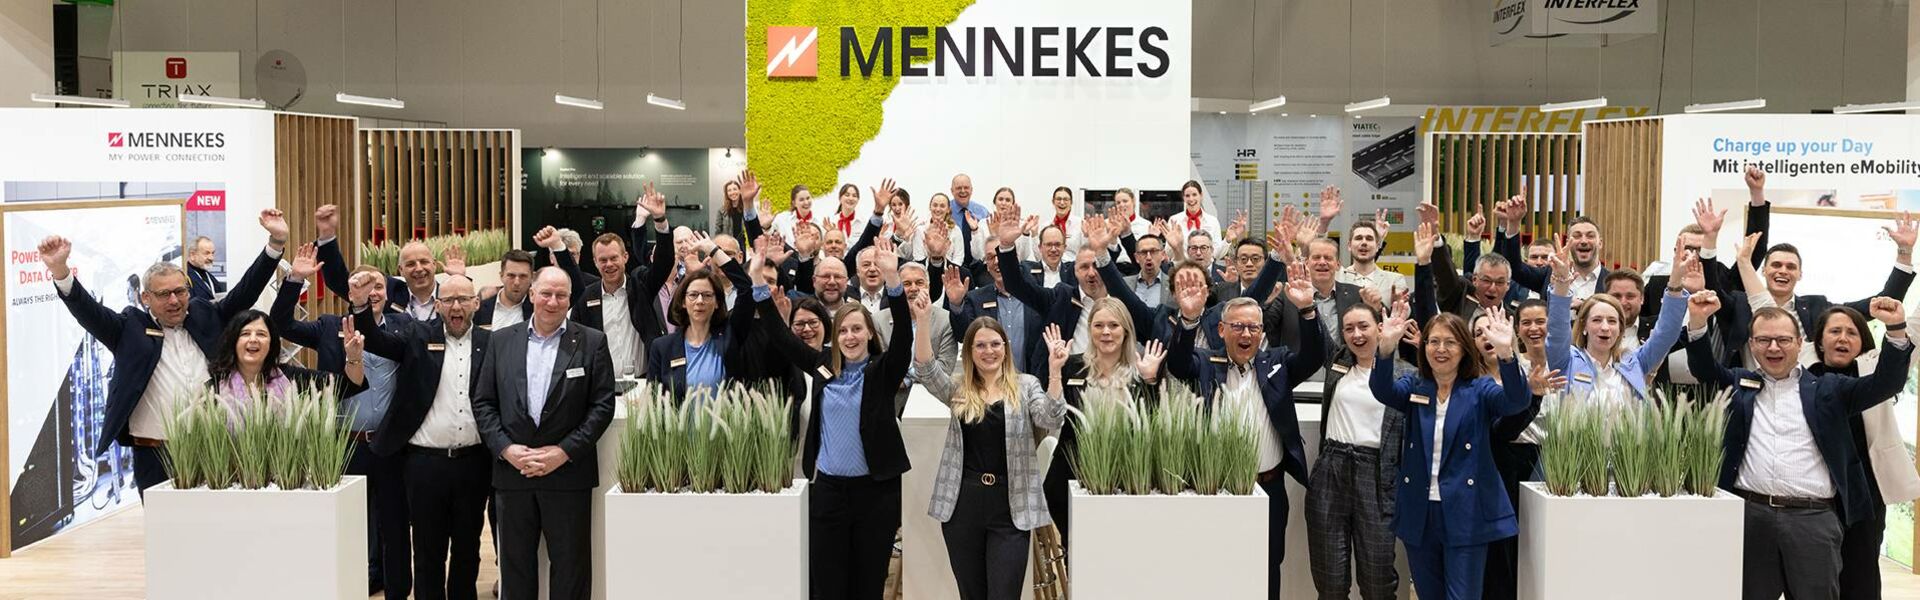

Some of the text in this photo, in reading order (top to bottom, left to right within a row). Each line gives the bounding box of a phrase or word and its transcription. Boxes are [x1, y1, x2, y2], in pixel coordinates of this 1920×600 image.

[839, 26, 1170, 78] MENNEKES
[141, 84, 212, 98] TRIAX
[128, 132, 225, 147] MENNEKES
[1237, 149, 1256, 157] HR
[1713, 138, 1873, 156] Charge up your Day
[108, 153, 225, 161] MY POWER CONNECTION
[1713, 159, 1738, 173] Mit
[1850, 160, 1920, 177] eMobility
[197, 195, 221, 206] NEW
[12, 250, 42, 264] POWE
[19, 270, 43, 284] DATA
[12, 293, 60, 306] ALWAYS THE RIGH
